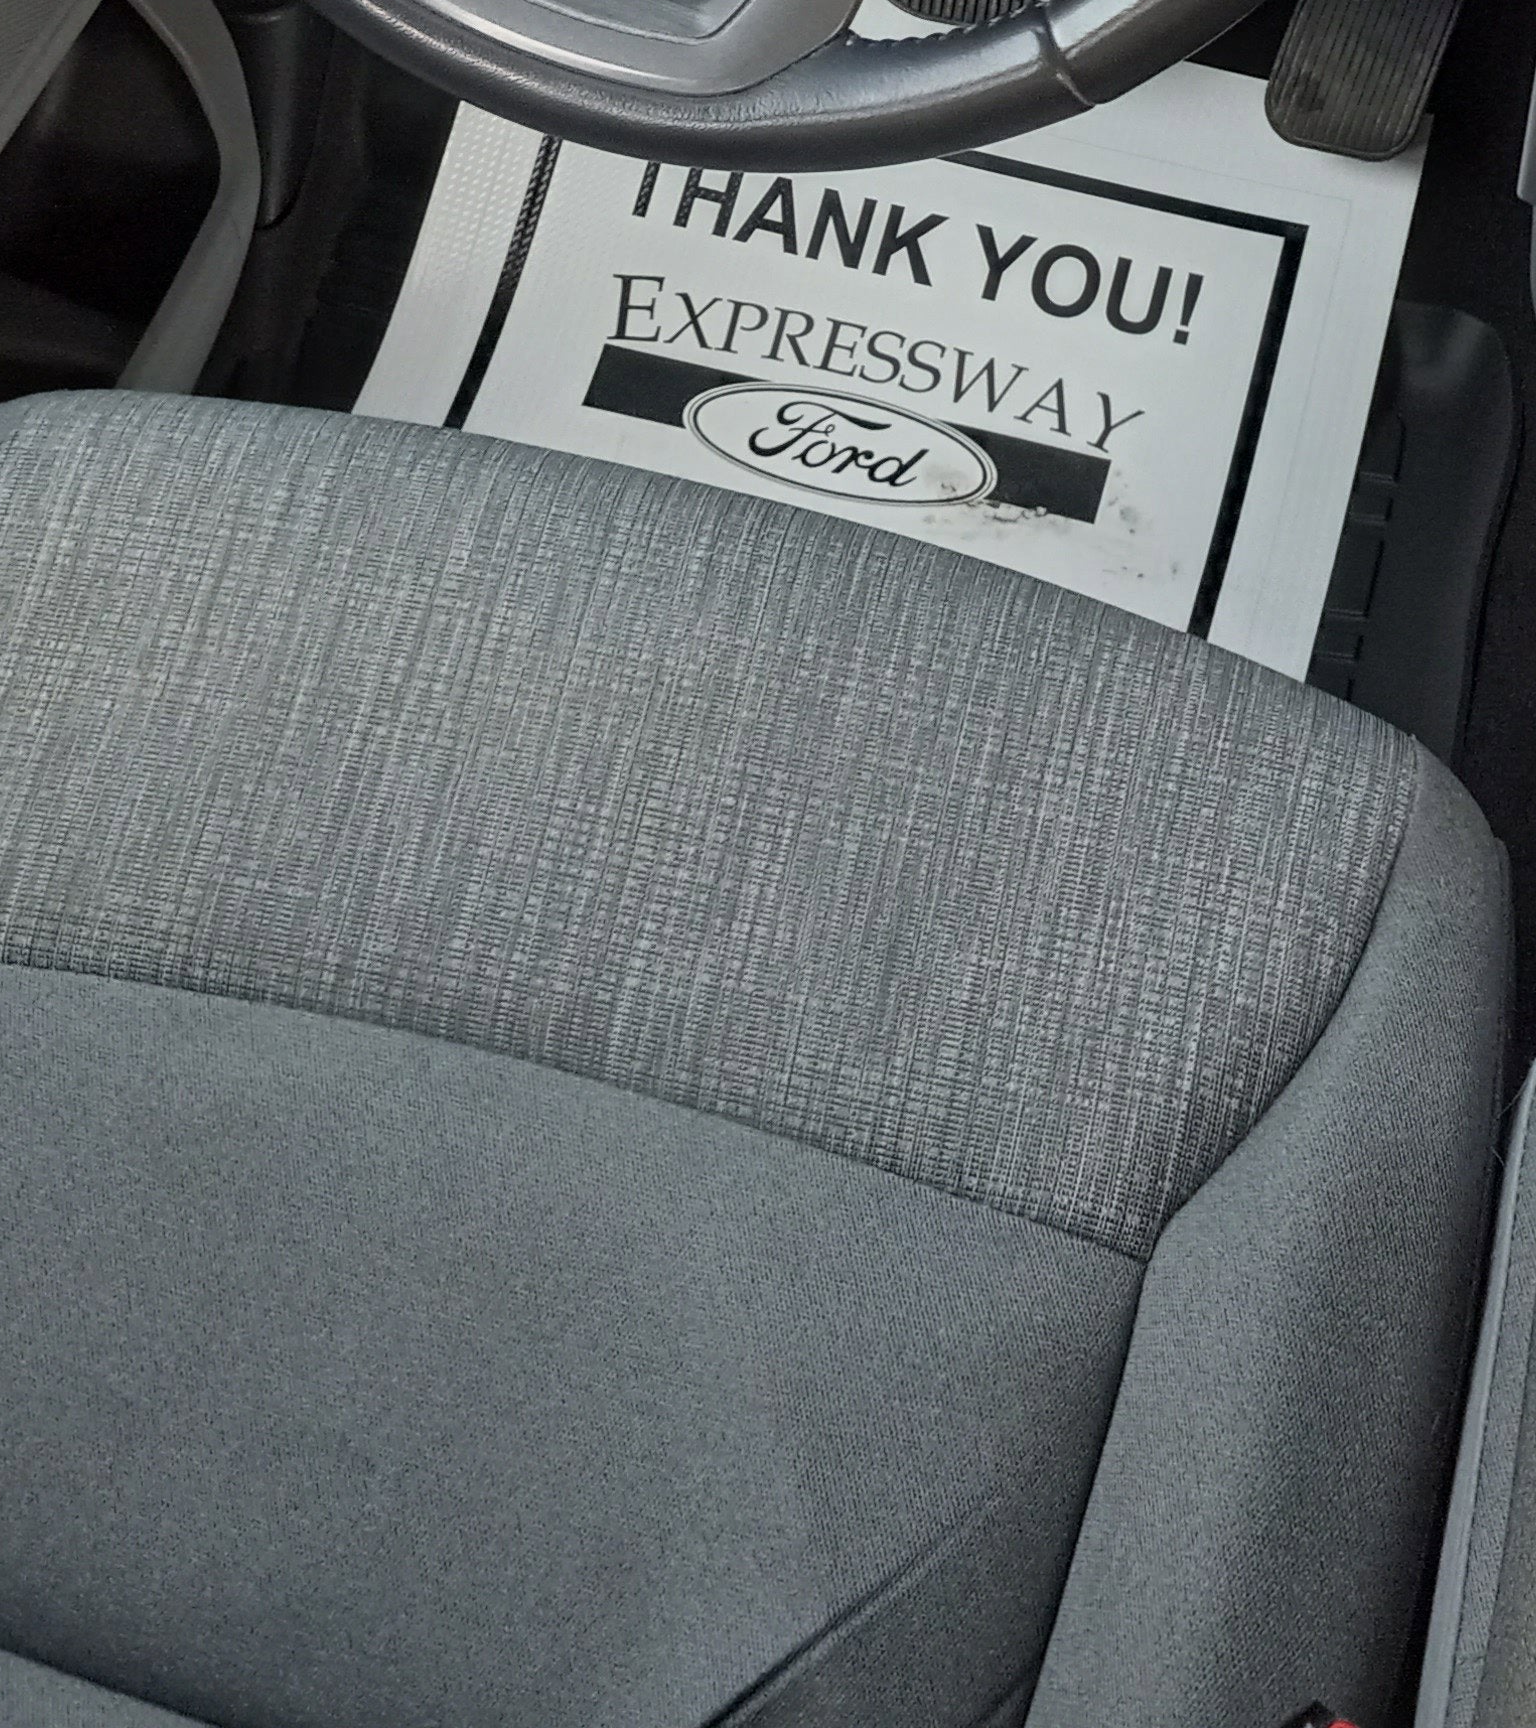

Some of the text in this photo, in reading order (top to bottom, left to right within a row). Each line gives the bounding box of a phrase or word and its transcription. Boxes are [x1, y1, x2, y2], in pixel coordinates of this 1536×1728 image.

[975, 222, 1204, 347] YOU!
[606, 273, 1146, 454] EXPRESSWAY
[747, 400, 930, 489] Ford
